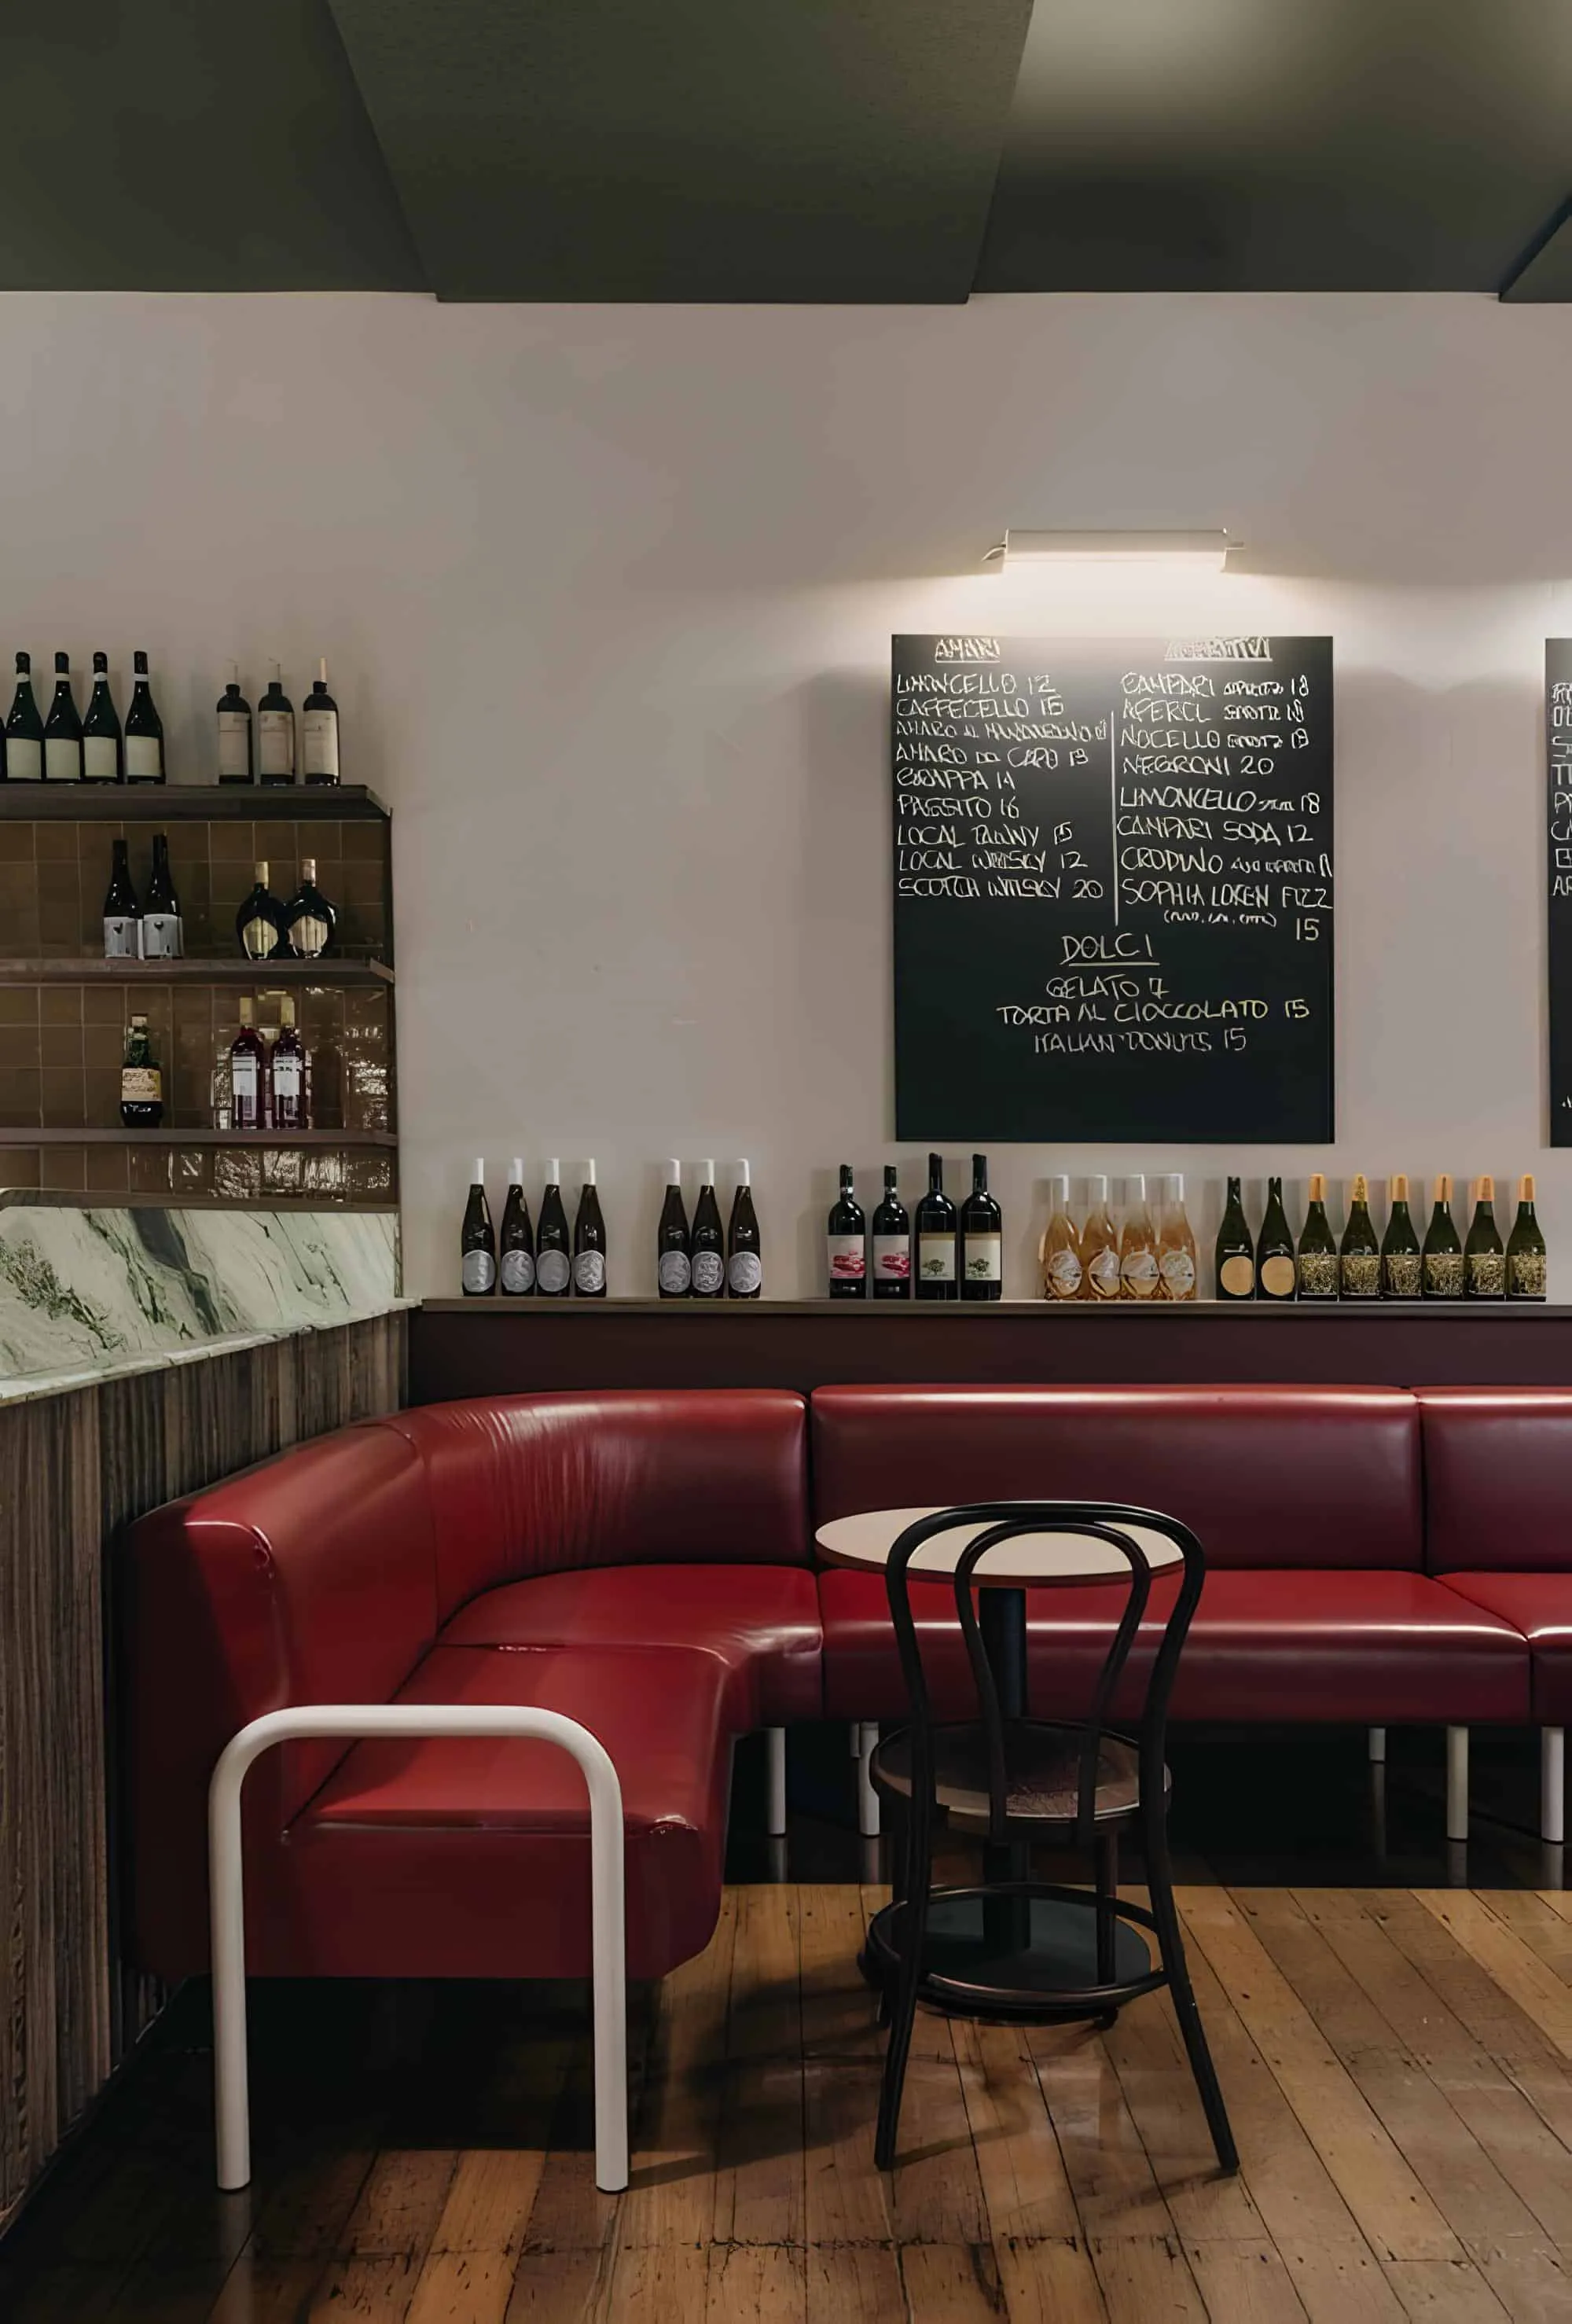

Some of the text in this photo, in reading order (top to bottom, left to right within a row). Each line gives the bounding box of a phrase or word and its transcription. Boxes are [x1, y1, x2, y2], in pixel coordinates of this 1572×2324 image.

[1120, 724, 1221, 749] NOCELLO
[1122, 754, 1274, 776] NEGRONI 20
[1119, 785, 1257, 811] LIMONCELLO
[898, 824, 966, 848] LOCAL
[1222, 821, 1281, 846] SODA
[1287, 825, 1313, 842] 12
[899, 851, 962, 871] LOCAL
[1061, 851, 1088, 869] 12
[1071, 879, 1104, 899] 20
[1122, 878, 1205, 906] SOPHIA
[1295, 917, 1320, 941] 15
[1060, 933, 1153, 965] DOLCI
[1046, 973, 1140, 999] GELATO
[997, 1006, 1070, 1025] TORTA
[1078, 1003, 1107, 1021] AL
[1285, 998, 1310, 1019] 15
[1034, 1031, 1115, 1054] ITALIAN
[1224, 1028, 1247, 1051] 15
